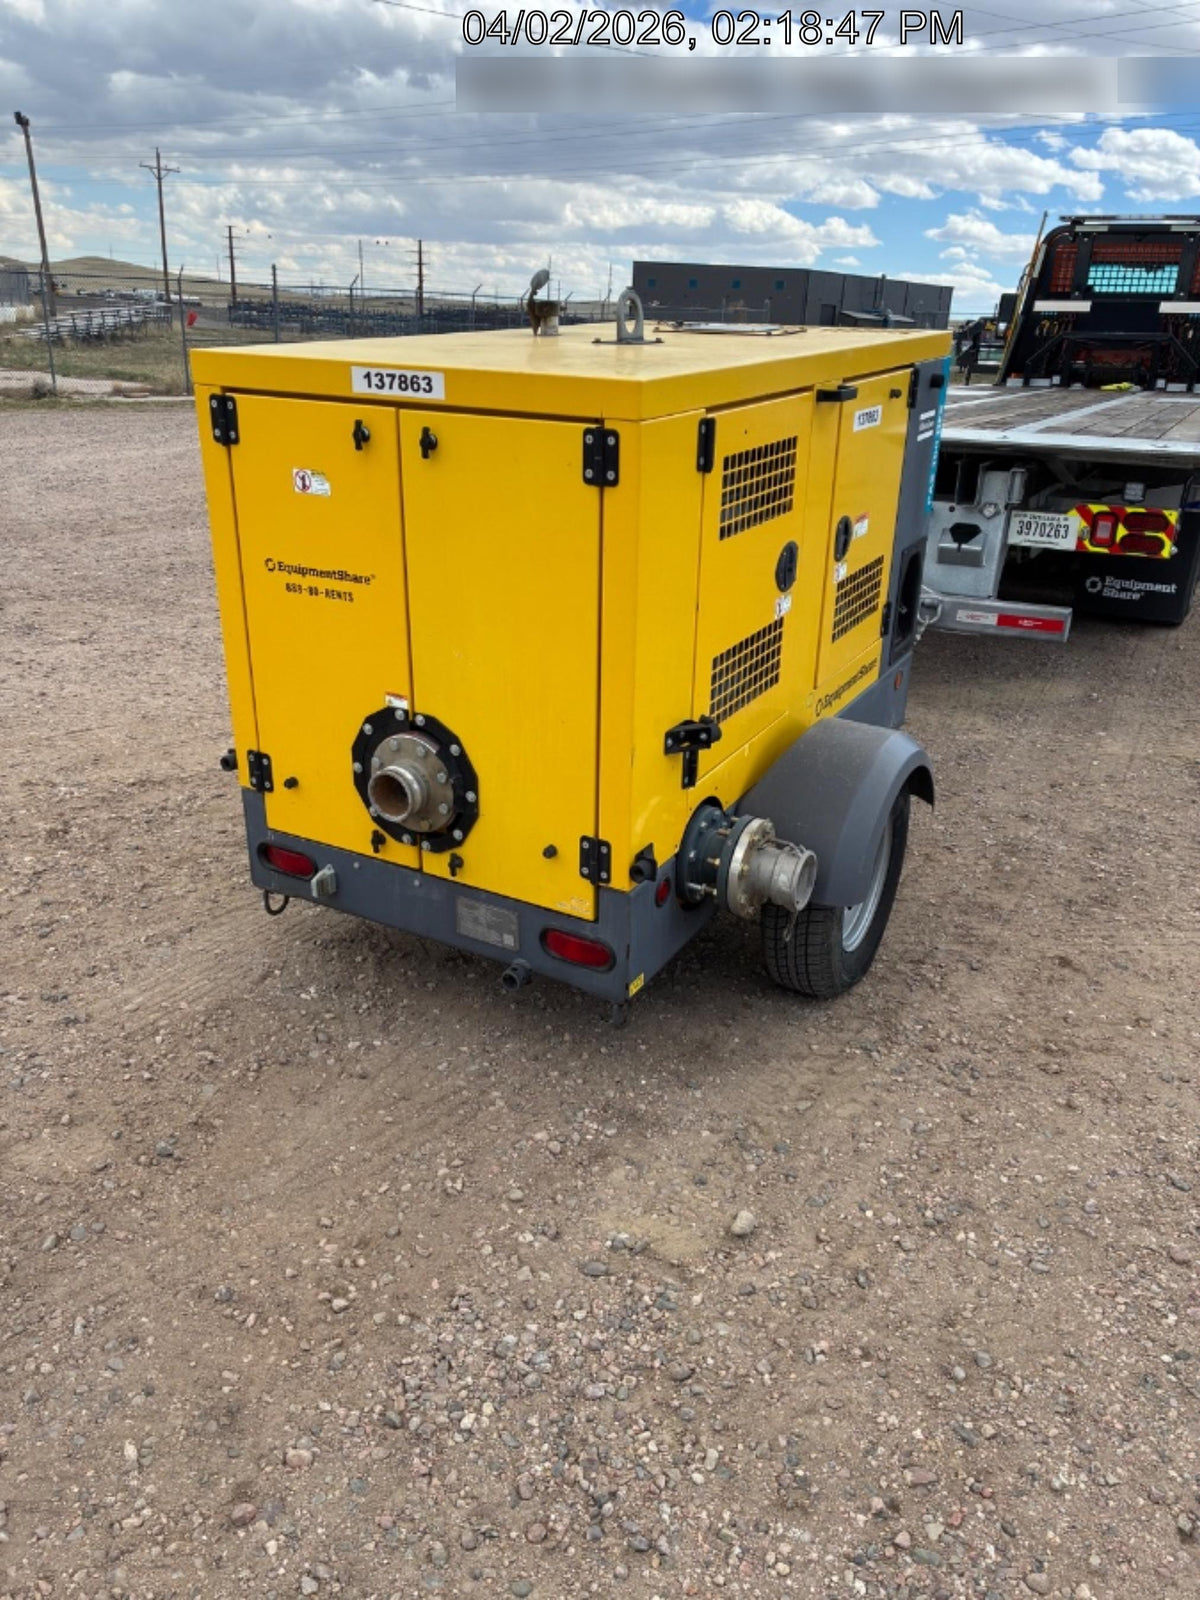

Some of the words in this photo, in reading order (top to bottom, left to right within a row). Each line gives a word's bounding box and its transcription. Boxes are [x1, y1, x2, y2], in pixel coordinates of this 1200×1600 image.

[363, 371, 433, 394] 137863
[1016, 520, 1070, 540] 3970263
[1105, 576, 1177, 594] Equipment
